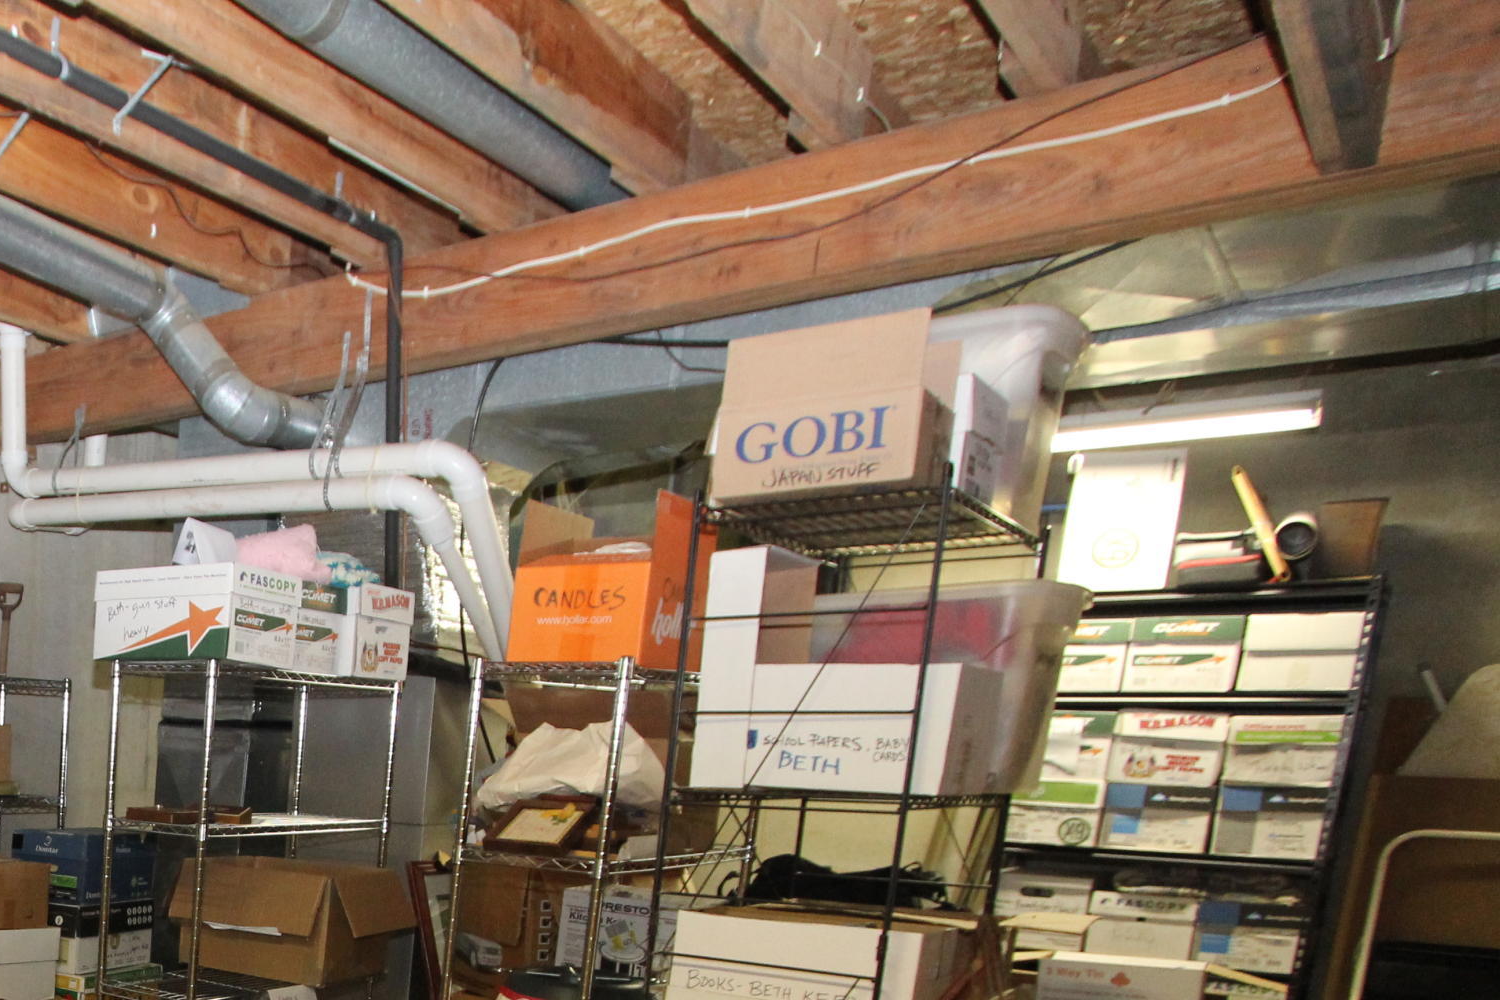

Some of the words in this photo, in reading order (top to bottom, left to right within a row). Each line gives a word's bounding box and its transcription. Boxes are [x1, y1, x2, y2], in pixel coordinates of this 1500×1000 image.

[735, 405, 891, 464] GOBI
[762, 469, 822, 488] JAPAN
[827, 461, 880, 481] STUFF
[250, 573, 297, 592] FASCOPY
[533, 586, 626, 611] CANDLES
[236, 612, 266, 627] COMET
[124, 626, 149, 641] heavy
[763, 735, 805, 747] SCHOOL
[778, 750, 841, 776] BETH
[749, 980, 792, 1000] BETH
